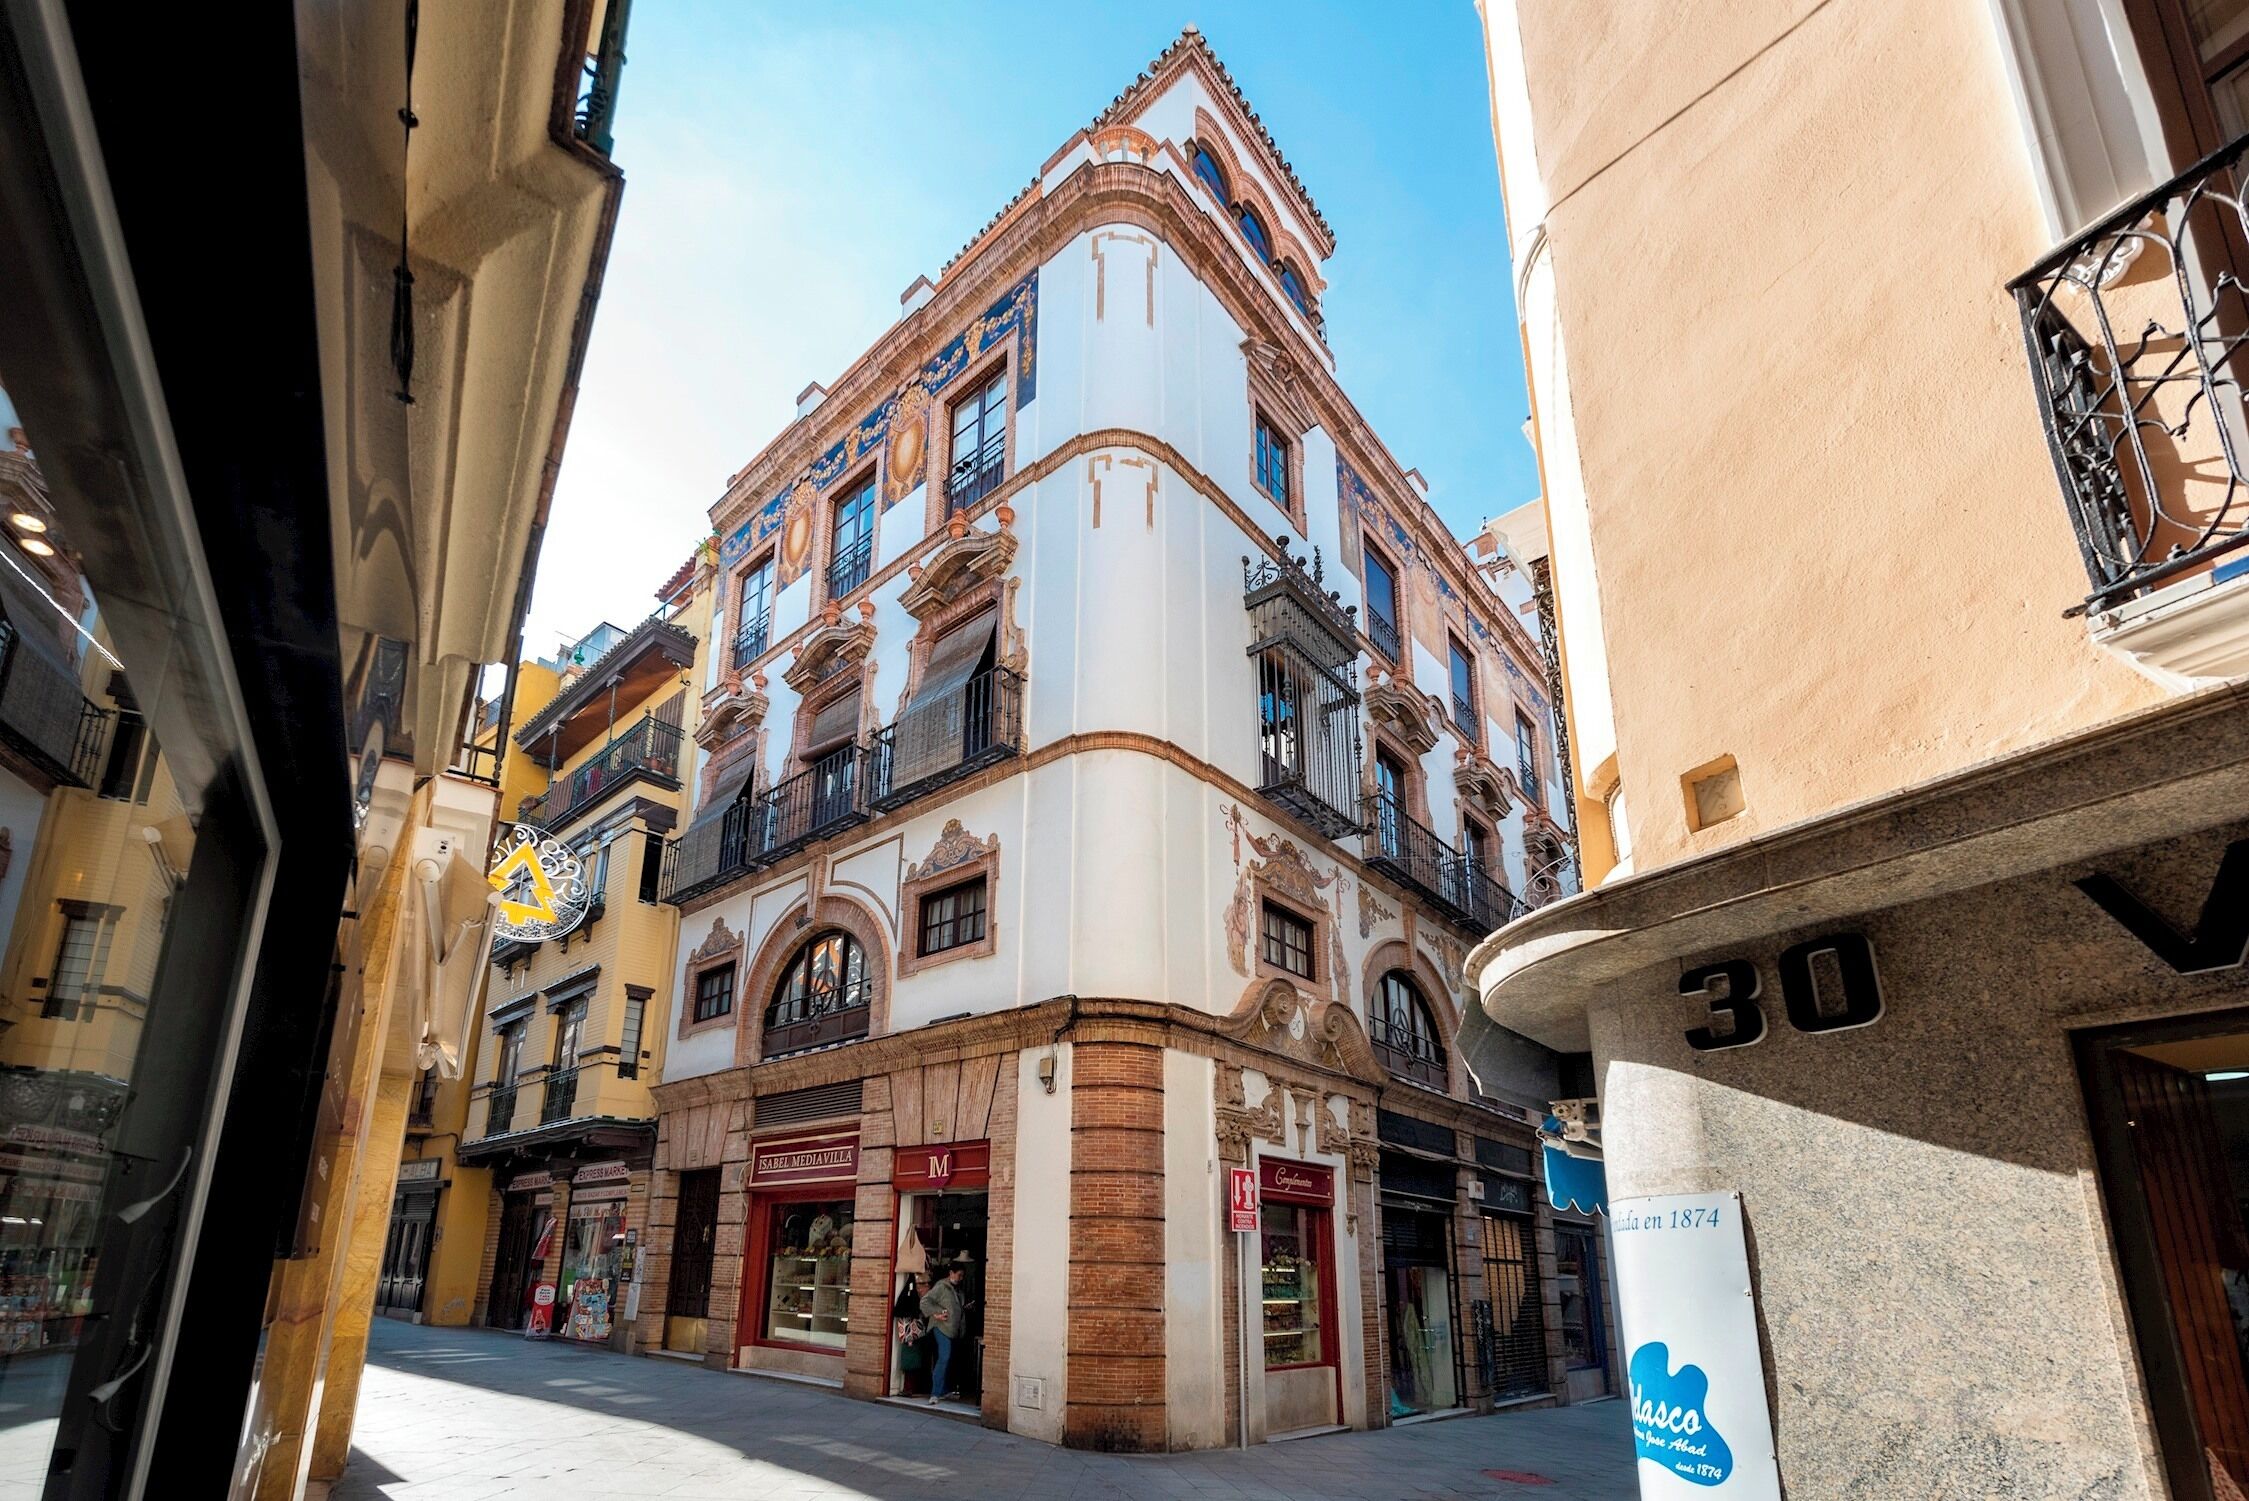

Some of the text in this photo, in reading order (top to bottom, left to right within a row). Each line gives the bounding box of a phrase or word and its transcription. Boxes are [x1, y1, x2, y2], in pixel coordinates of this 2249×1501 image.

[1679, 931, 1886, 1052] 30
[758, 1150, 852, 1171] ISABEL MEDIAVILLA
[578, 1165, 628, 1181] EXPRESS MARKET
[1644, 1215, 1662, 1230] en
[1670, 1207, 1720, 1229] 1874
[1668, 1438, 1707, 1457] Abad
[1675, 1461, 1722, 1480] desde 1874
